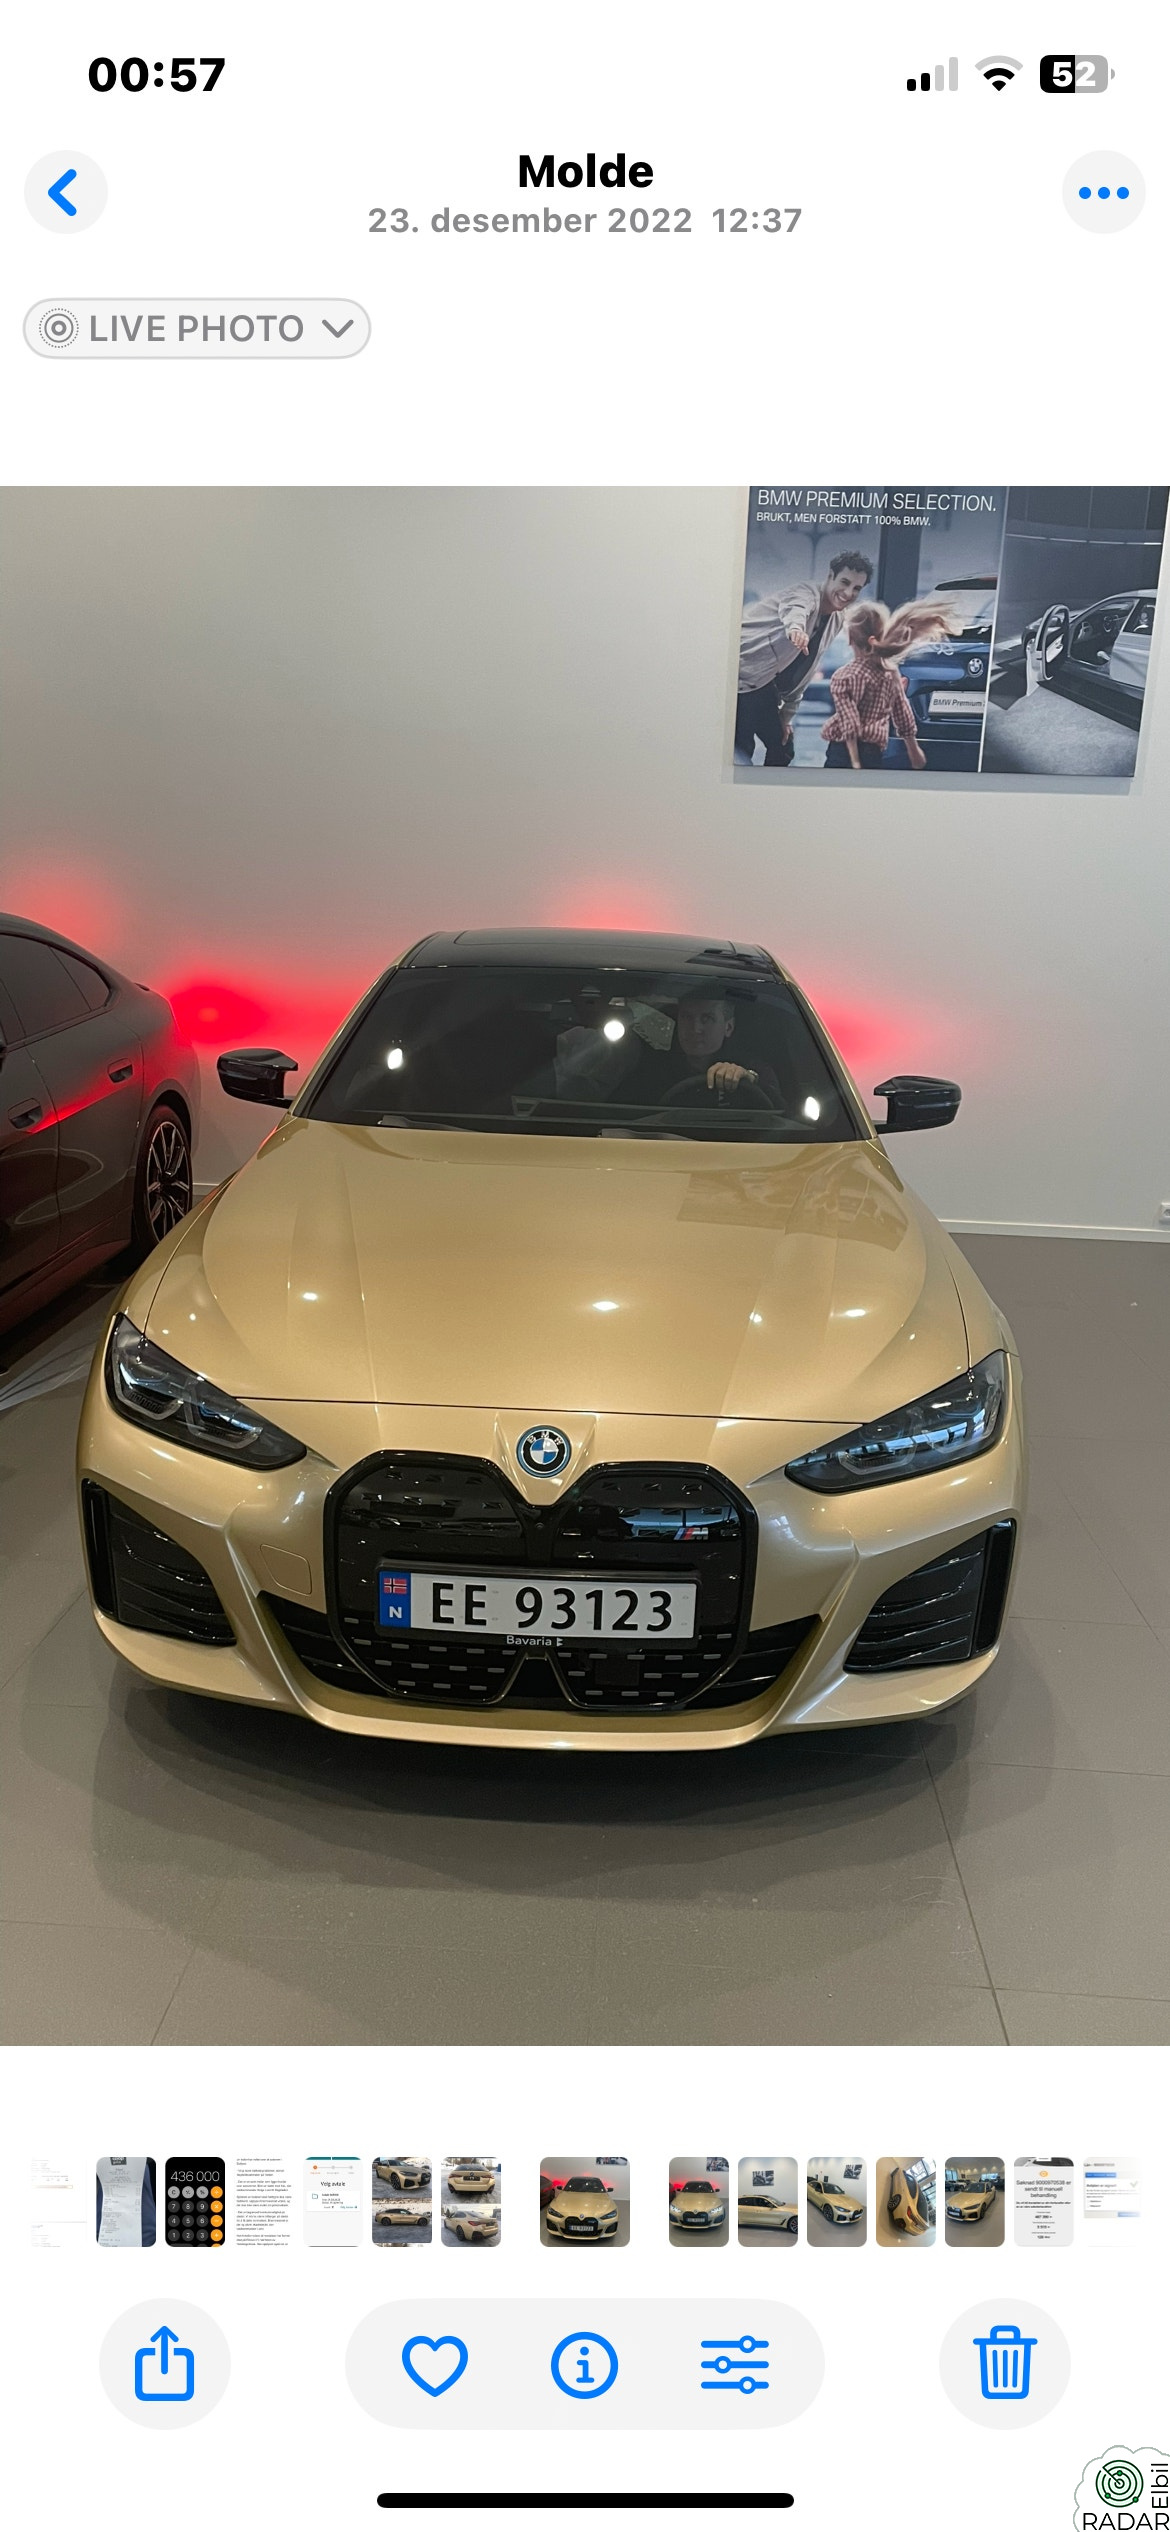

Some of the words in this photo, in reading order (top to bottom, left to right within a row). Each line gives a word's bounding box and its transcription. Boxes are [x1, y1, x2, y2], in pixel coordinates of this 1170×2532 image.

[88, 56, 226, 93] 00:57
[1052, 61, 1096, 87] 52
[519, 152, 654, 189] Molde
[368, 209, 419, 234] 23.
[430, 206, 598, 234] desember
[608, 209, 692, 234] 2022
[712, 209, 802, 234] 12:37
[90, 314, 166, 343] LIVE
[178, 314, 304, 343] PHOTO
[758, 489, 803, 506] BMW
[806, 490, 889, 508] PREMIUM
[892, 493, 996, 512] SELECTION.
[756, 512, 792, 523] BRUKT,
[794, 513, 817, 523] MEN
[819, 513, 872, 525] FORSTATT
[874, 515, 901, 525] 100%
[903, 516, 931, 526] BMW.
[952, 699, 982, 707] Premium
[389, 1606, 402, 1619] N
[432, 1582, 487, 1626] EE
[515, 1586, 672, 1632] 93123
[506, 1635, 552, 1646] Bavaria
[170, 2170, 194, 2182] 436
[196, 2170, 220, 2182] 000
